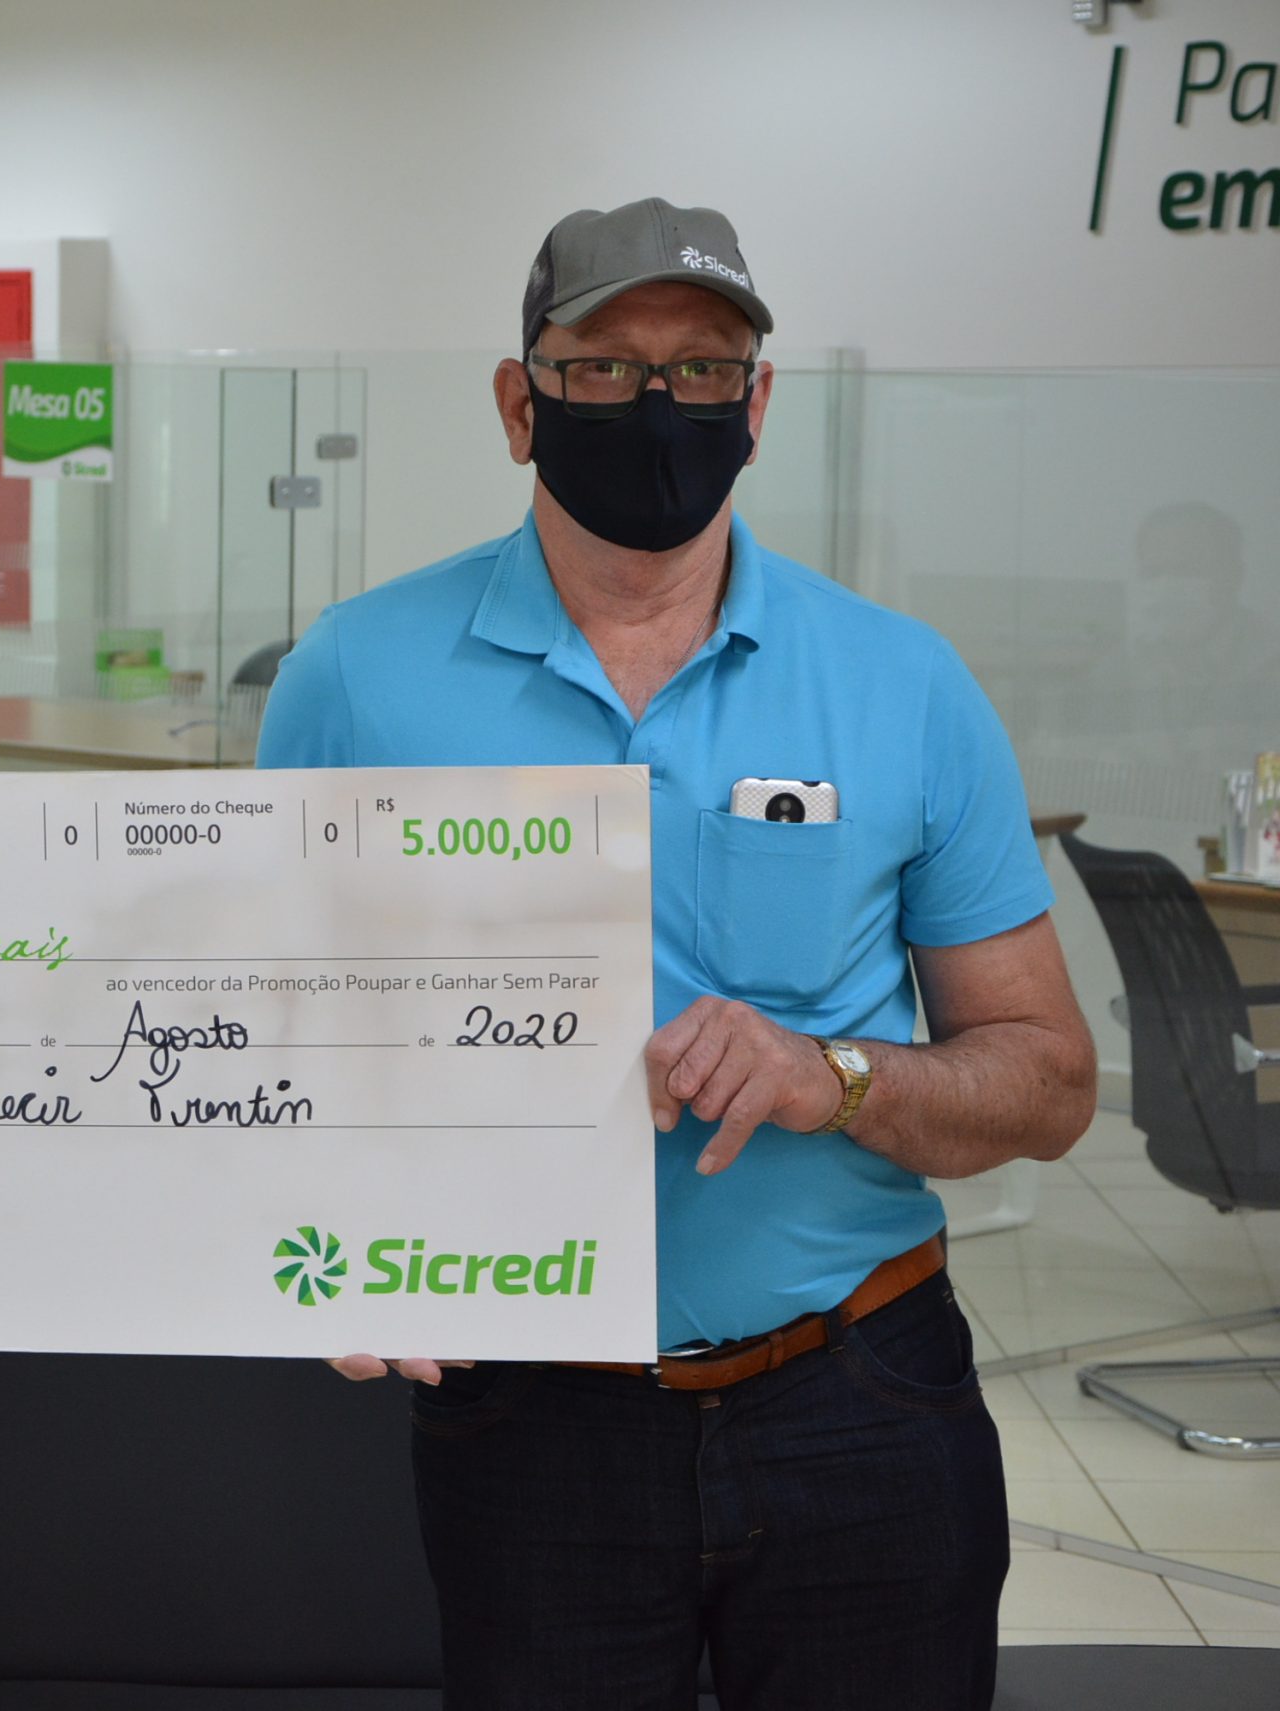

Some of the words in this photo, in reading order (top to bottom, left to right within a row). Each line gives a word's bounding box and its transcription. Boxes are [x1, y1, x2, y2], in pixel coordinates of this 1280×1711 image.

[704, 255, 749, 289] Sicredi
[7, 384, 71, 418] Mesa
[74, 386, 106, 421] 05
[124, 799, 185, 816] Número
[189, 800, 211, 815] do
[214, 799, 274, 818] Cheque
[375, 796, 396, 813] R$
[63, 824, 79, 846] 0
[124, 823, 222, 846] 00000-0
[323, 821, 339, 844] 0
[402, 817, 573, 861] 5.000,00
[126, 847, 162, 856] 00000-0
[105, 978, 128, 992] ao
[131, 975, 217, 992] vencedor
[220, 975, 244, 992] da
[248, 974, 341, 996] Promoção
[345, 975, 412, 995] Poupar
[415, 978, 427, 991] e
[431, 973, 499, 991] Ganhar
[502, 972, 543, 990] Sem
[548, 973, 601, 989] Parar
[455, 1005, 578, 1047] 2020
[40, 1034, 57, 1048] de
[90, 1000, 249, 1082] Agosto
[418, 1034, 436, 1048] de
[362, 1239, 598, 1296] Sicredi
